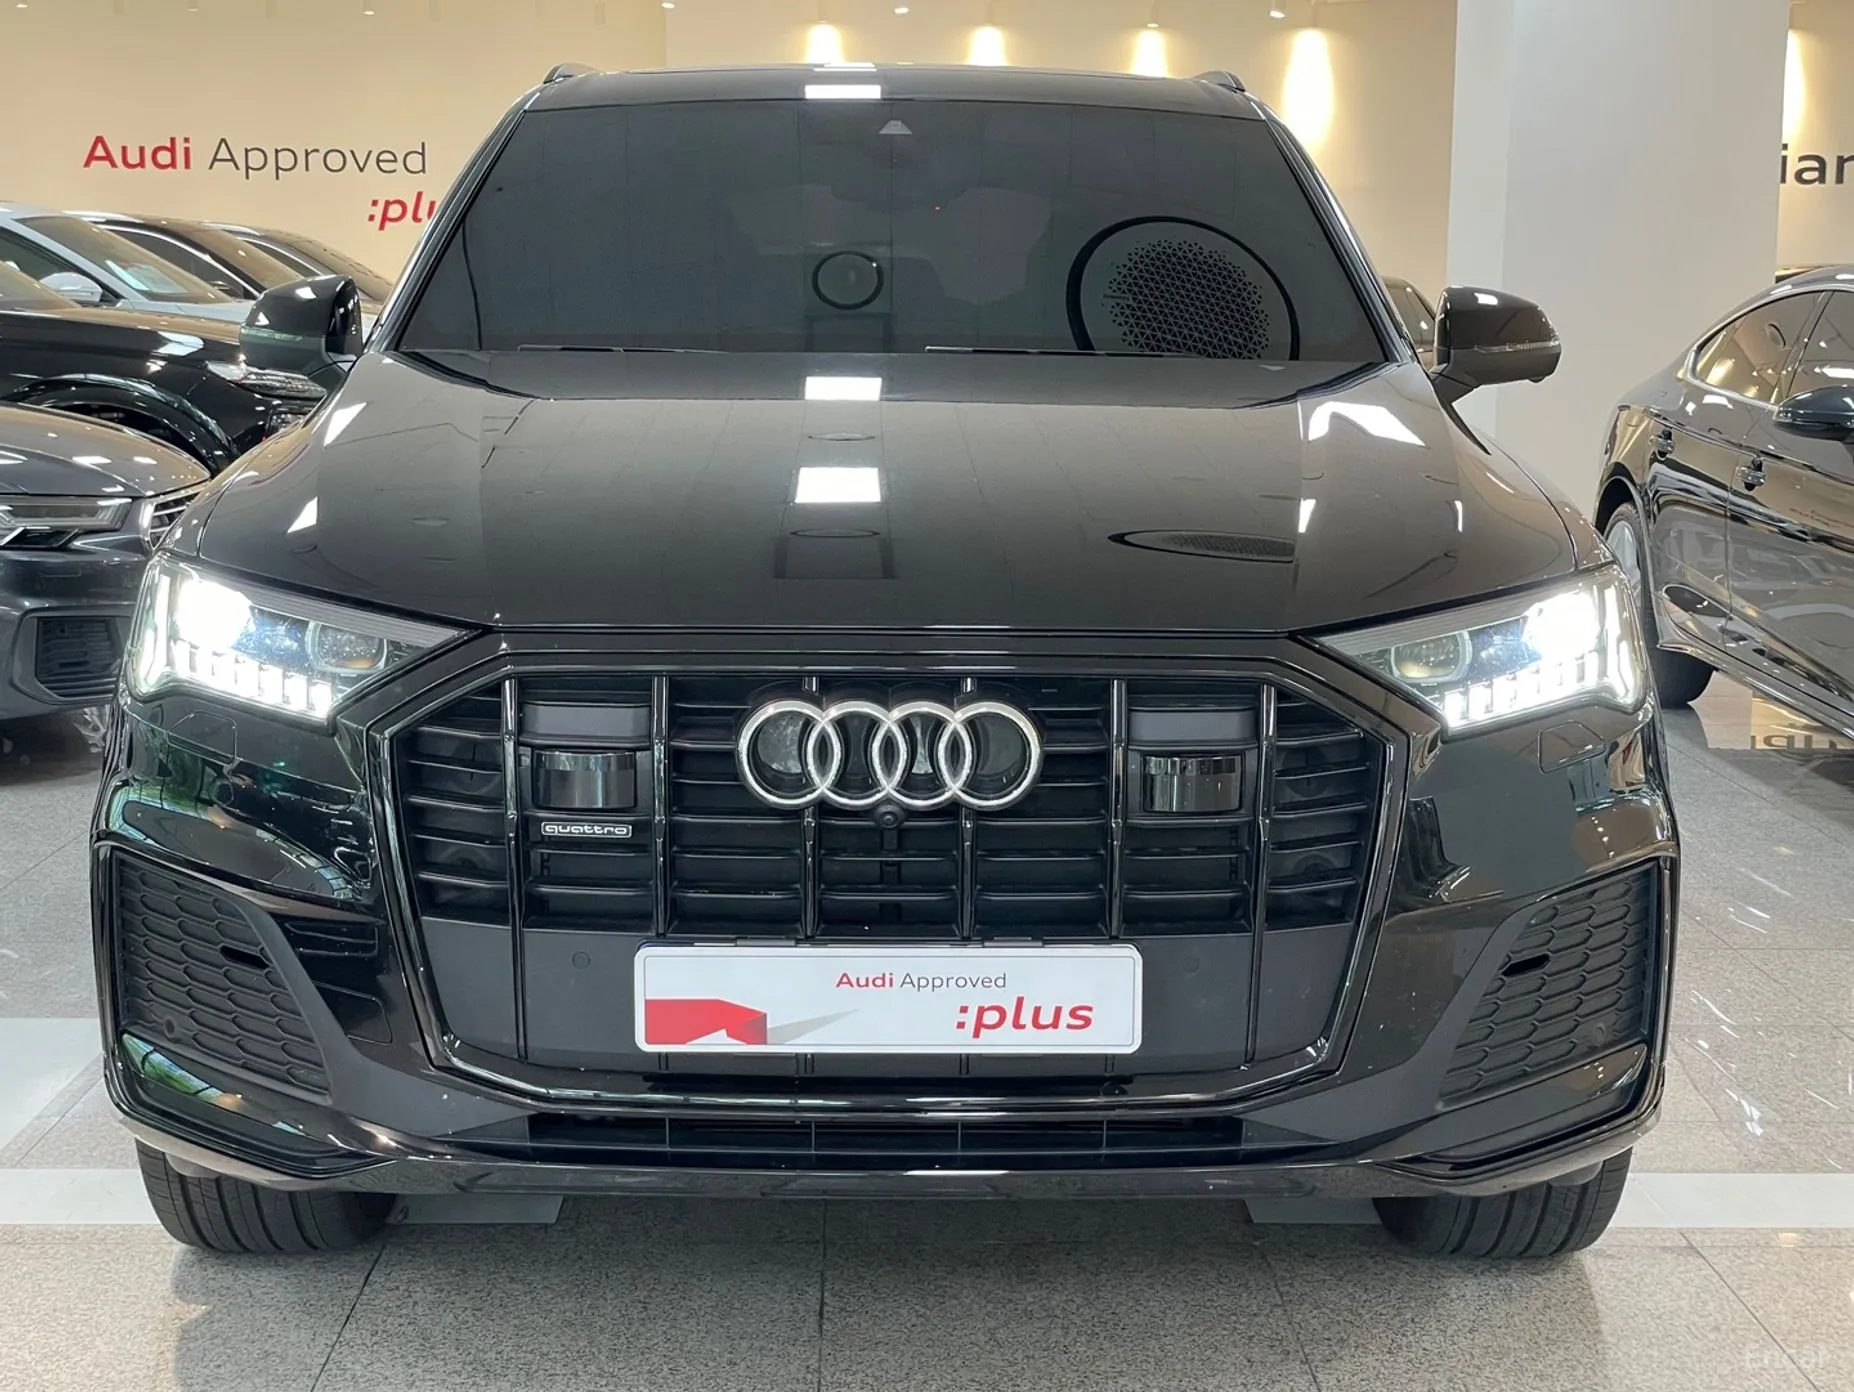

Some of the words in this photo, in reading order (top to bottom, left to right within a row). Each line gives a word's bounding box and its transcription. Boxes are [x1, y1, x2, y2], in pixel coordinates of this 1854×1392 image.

[83, 135, 191, 170] Audi
[208, 137, 426, 181] Approved
[543, 824, 629, 836] quattro
[836, 972, 894, 988] Audi
[900, 973, 1007, 992] Approved
[956, 996, 1094, 1039] :plus
